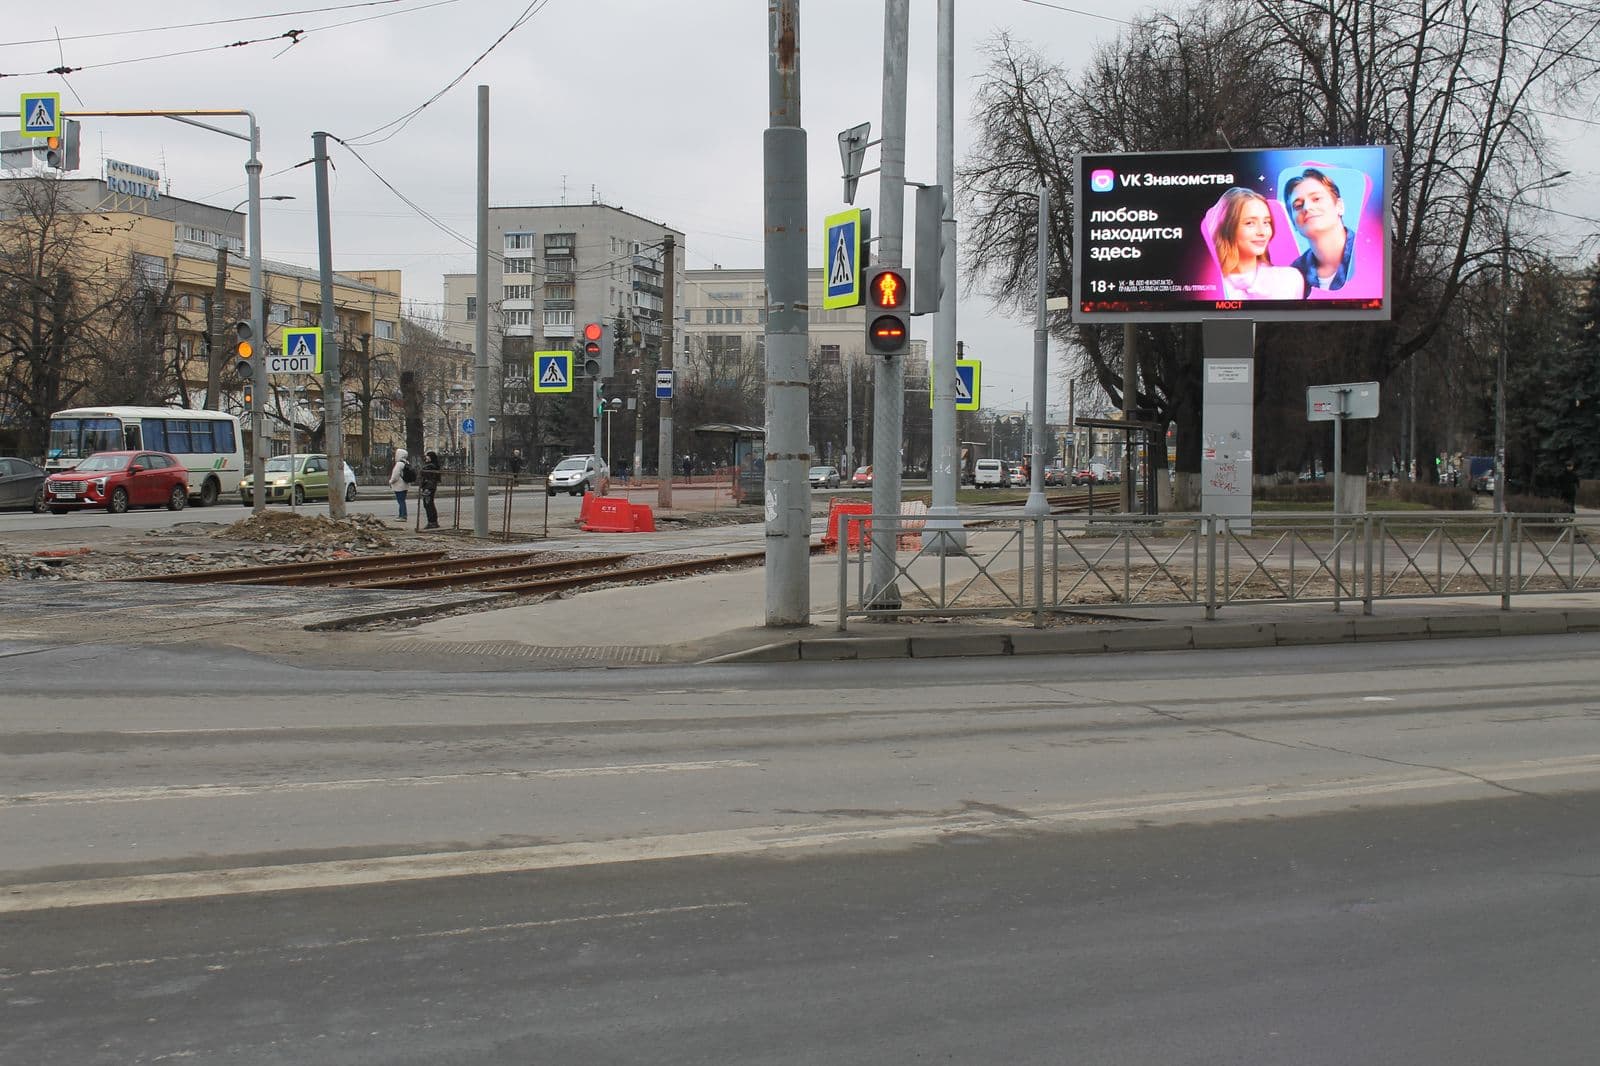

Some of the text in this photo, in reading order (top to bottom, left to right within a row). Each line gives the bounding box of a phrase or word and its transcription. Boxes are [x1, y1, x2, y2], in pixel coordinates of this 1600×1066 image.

[1119, 173, 1234, 187] VK Знакомства
[1090, 207, 1159, 222] любовь
[1090, 227, 1183, 242] находится
[1090, 246, 1142, 261] здесь
[1090, 280, 1116, 293] 18+
[1215, 301, 1242, 310] МОСТ
[271, 358, 309, 371] СТОП
